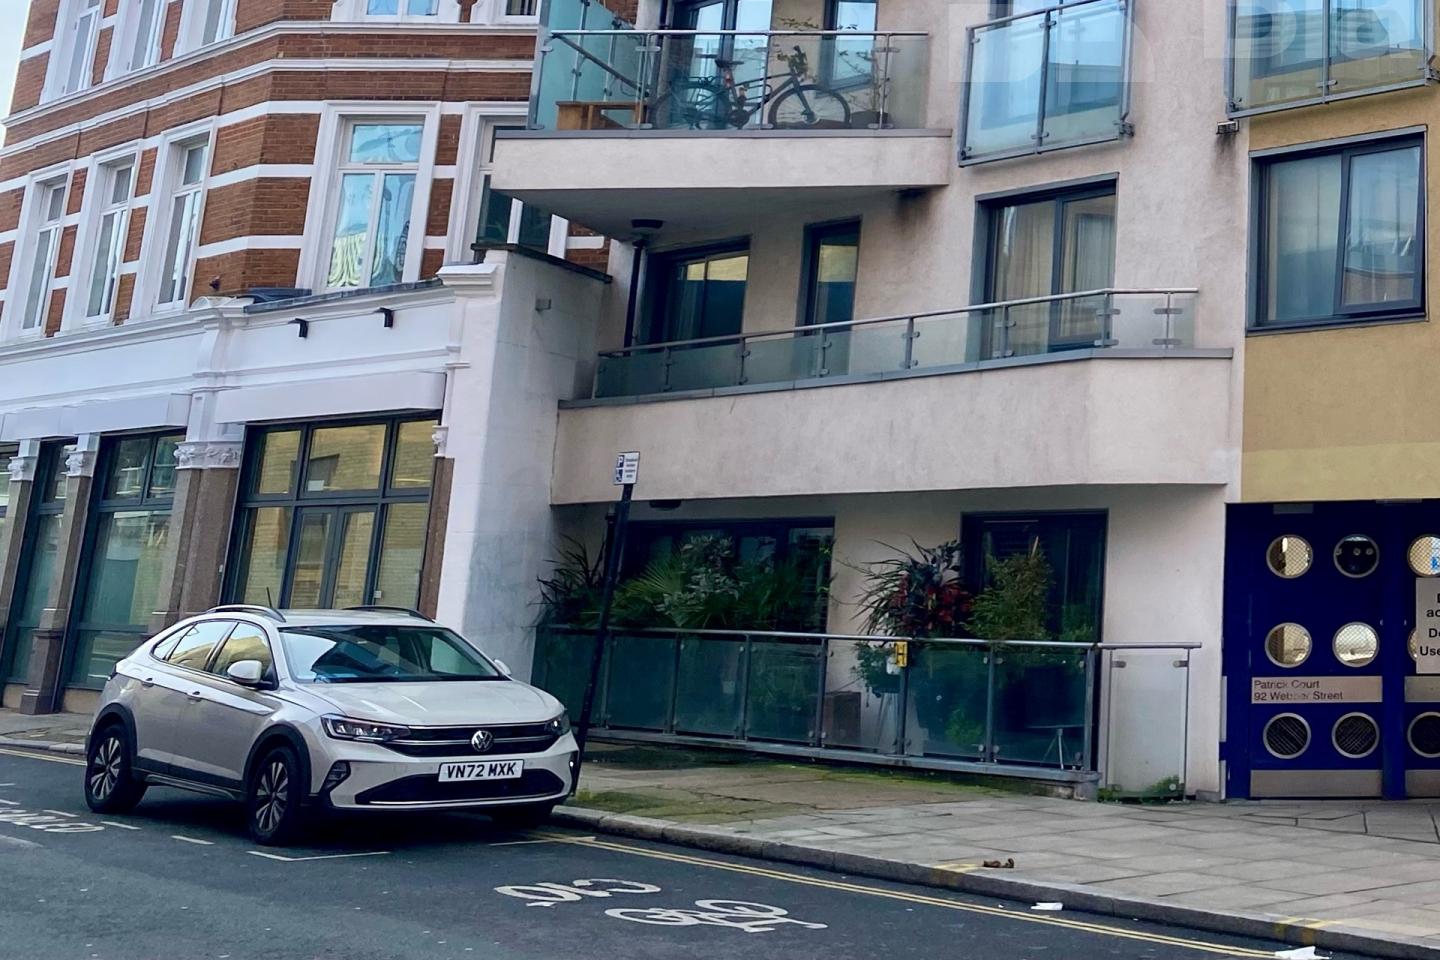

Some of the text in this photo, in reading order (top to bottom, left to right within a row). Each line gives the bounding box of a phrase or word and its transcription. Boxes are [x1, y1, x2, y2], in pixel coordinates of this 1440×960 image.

[1253, 679, 1320, 690] Patrick Court
[1254, 691, 1267, 701] 92
[1312, 690, 1344, 700] Street
[447, 761, 517, 779] VN72 MXK
